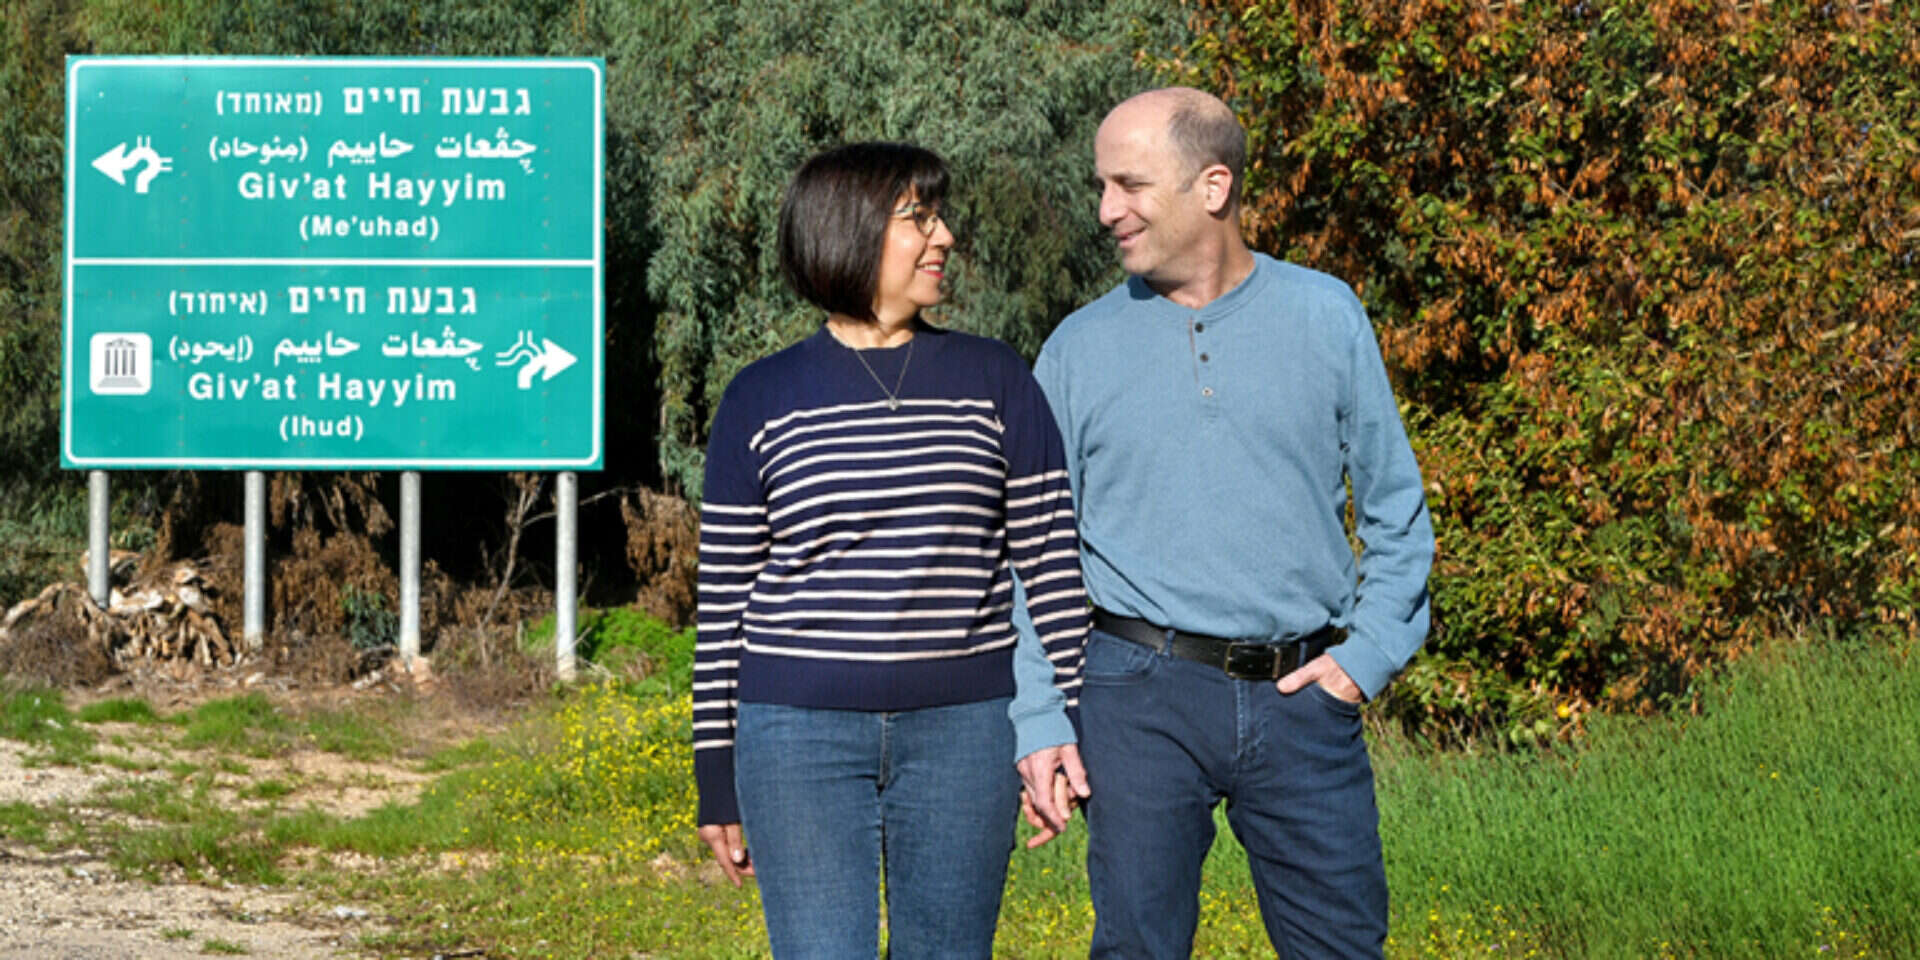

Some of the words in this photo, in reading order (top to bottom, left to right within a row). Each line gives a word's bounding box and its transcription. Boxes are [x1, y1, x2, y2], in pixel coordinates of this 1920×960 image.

[215, 89, 323, 117] (מאוחד)
[342, 86, 421, 116] חיים
[441, 87, 531, 116] גבעת
[327, 132, 415, 169] حاييم
[368, 171, 506, 207] Hayyim
[168, 289, 268, 316] (איחוד)
[287, 286, 366, 315] חיים
[386, 286, 477, 315] גבעת
[273, 330, 361, 367] حاييم
[318, 372, 457, 407] Hayyim
[279, 415, 364, 441] (Ihud)
